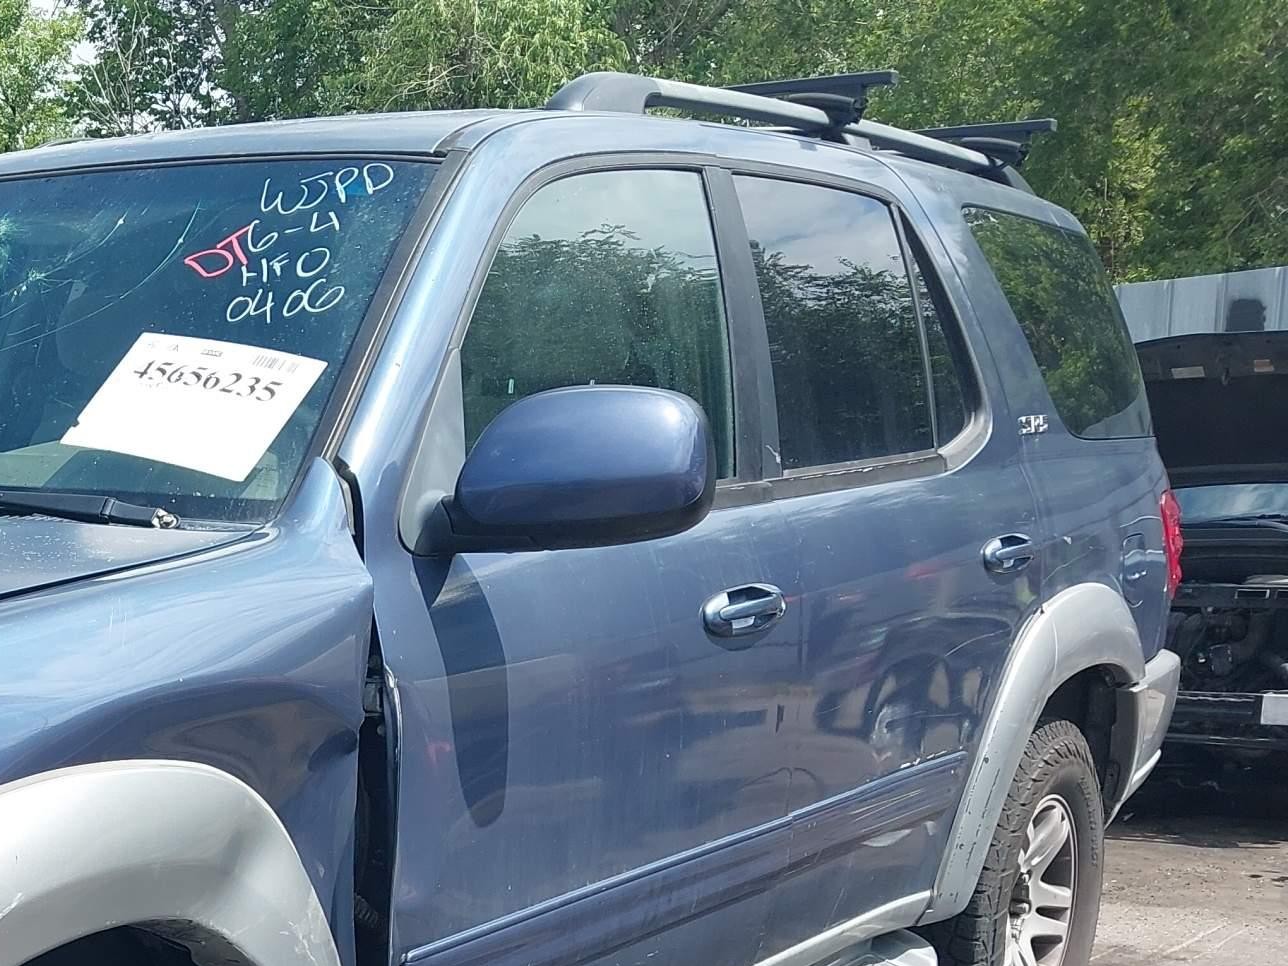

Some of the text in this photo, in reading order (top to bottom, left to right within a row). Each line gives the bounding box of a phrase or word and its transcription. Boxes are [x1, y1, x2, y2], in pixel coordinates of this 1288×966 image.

[184, 225, 253, 278] DT
[247, 211, 340, 253] 6-4
[133, 359, 284, 402] 45656235
